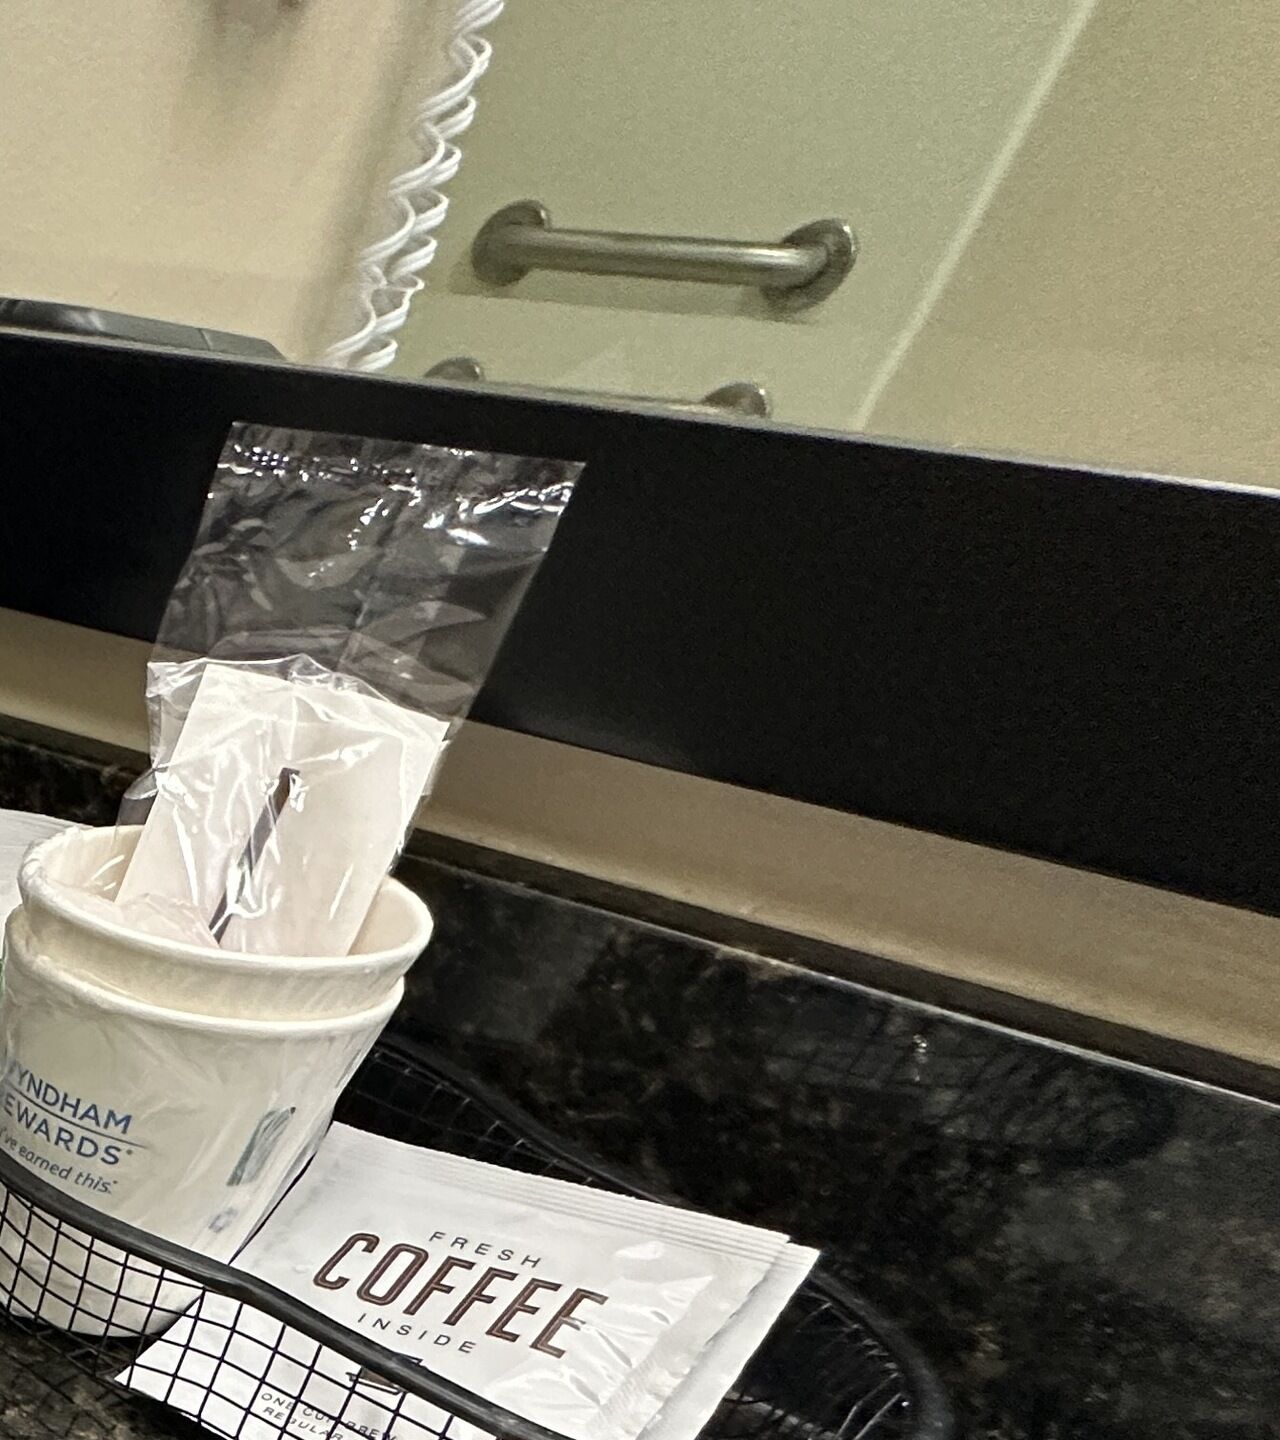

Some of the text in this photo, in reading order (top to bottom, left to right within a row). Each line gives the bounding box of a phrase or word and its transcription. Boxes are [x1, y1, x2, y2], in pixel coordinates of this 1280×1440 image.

[18, 1145, 73, 1181] earned
[428, 1230, 543, 1268] FRESH
[312, 1231, 610, 1360] COFFEE
[357, 1311, 478, 1355] INSIDE
[261, 1391, 294, 1415] ONE
